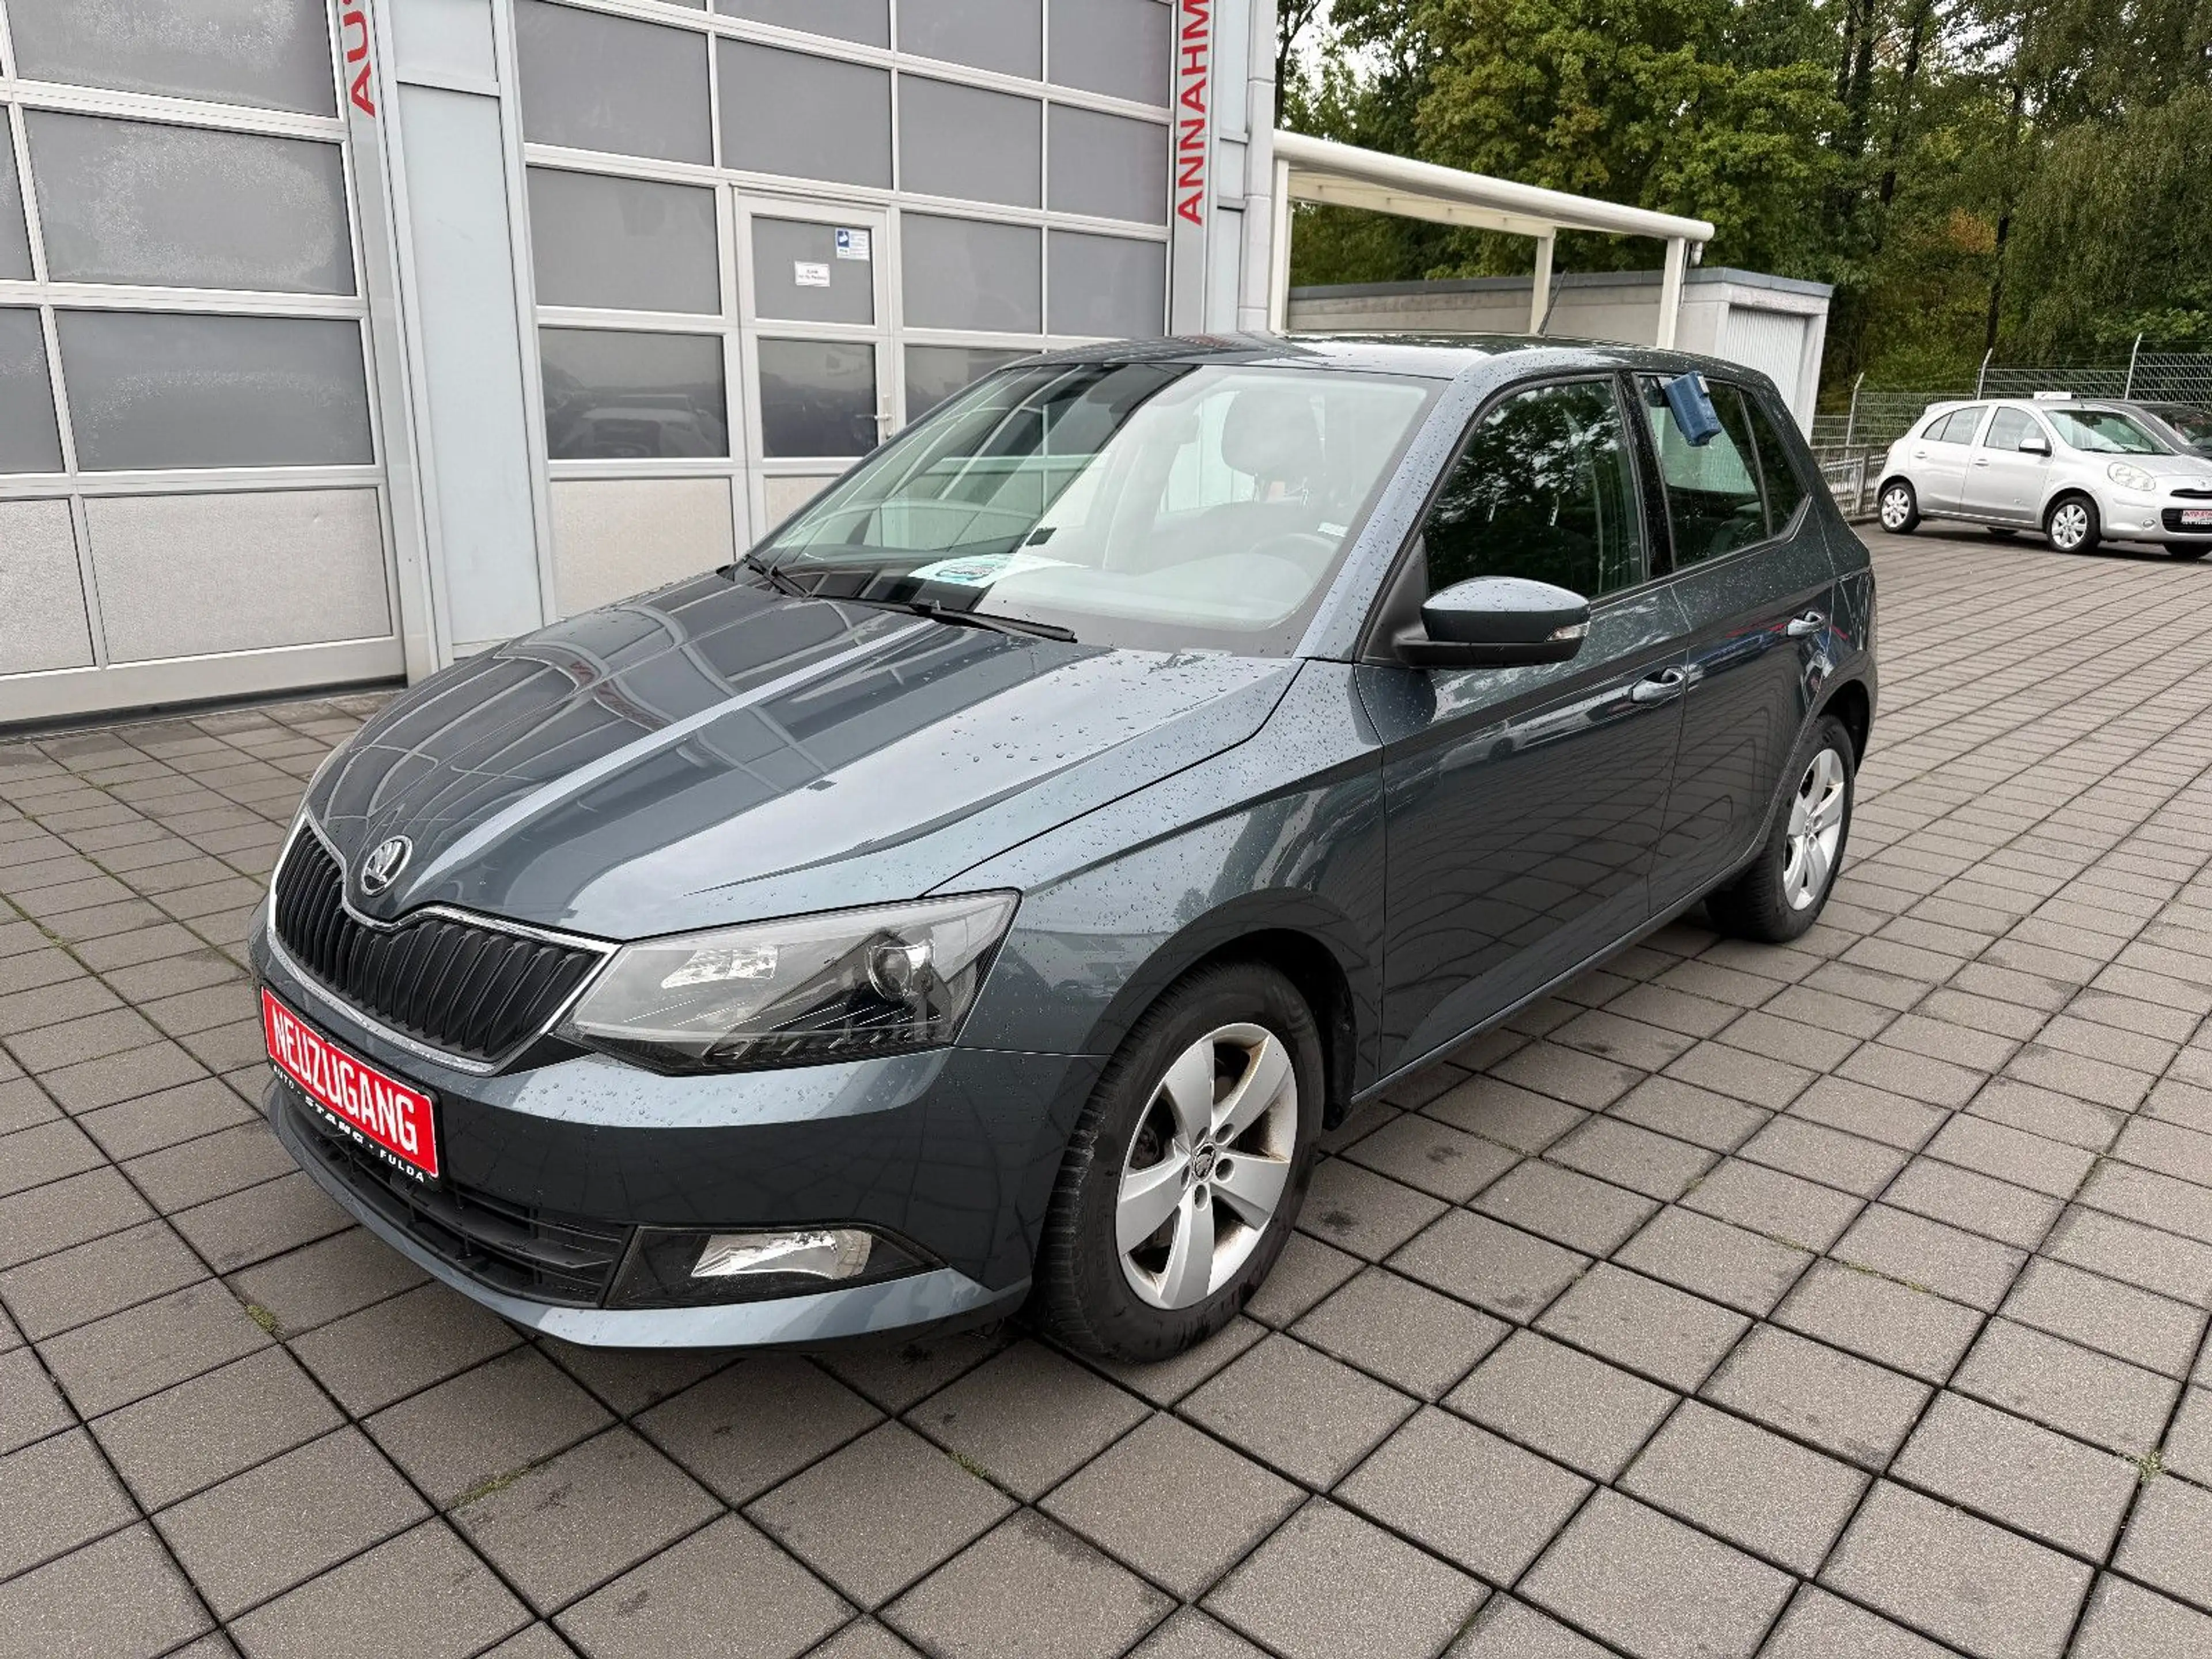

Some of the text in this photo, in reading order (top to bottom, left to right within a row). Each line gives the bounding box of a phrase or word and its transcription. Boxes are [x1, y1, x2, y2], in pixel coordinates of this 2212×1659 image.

[342, 0, 376, 118] AU
[271, 1005, 419, 1155] NEUZUGANG
[380, 1149, 425, 1183] FULDA
